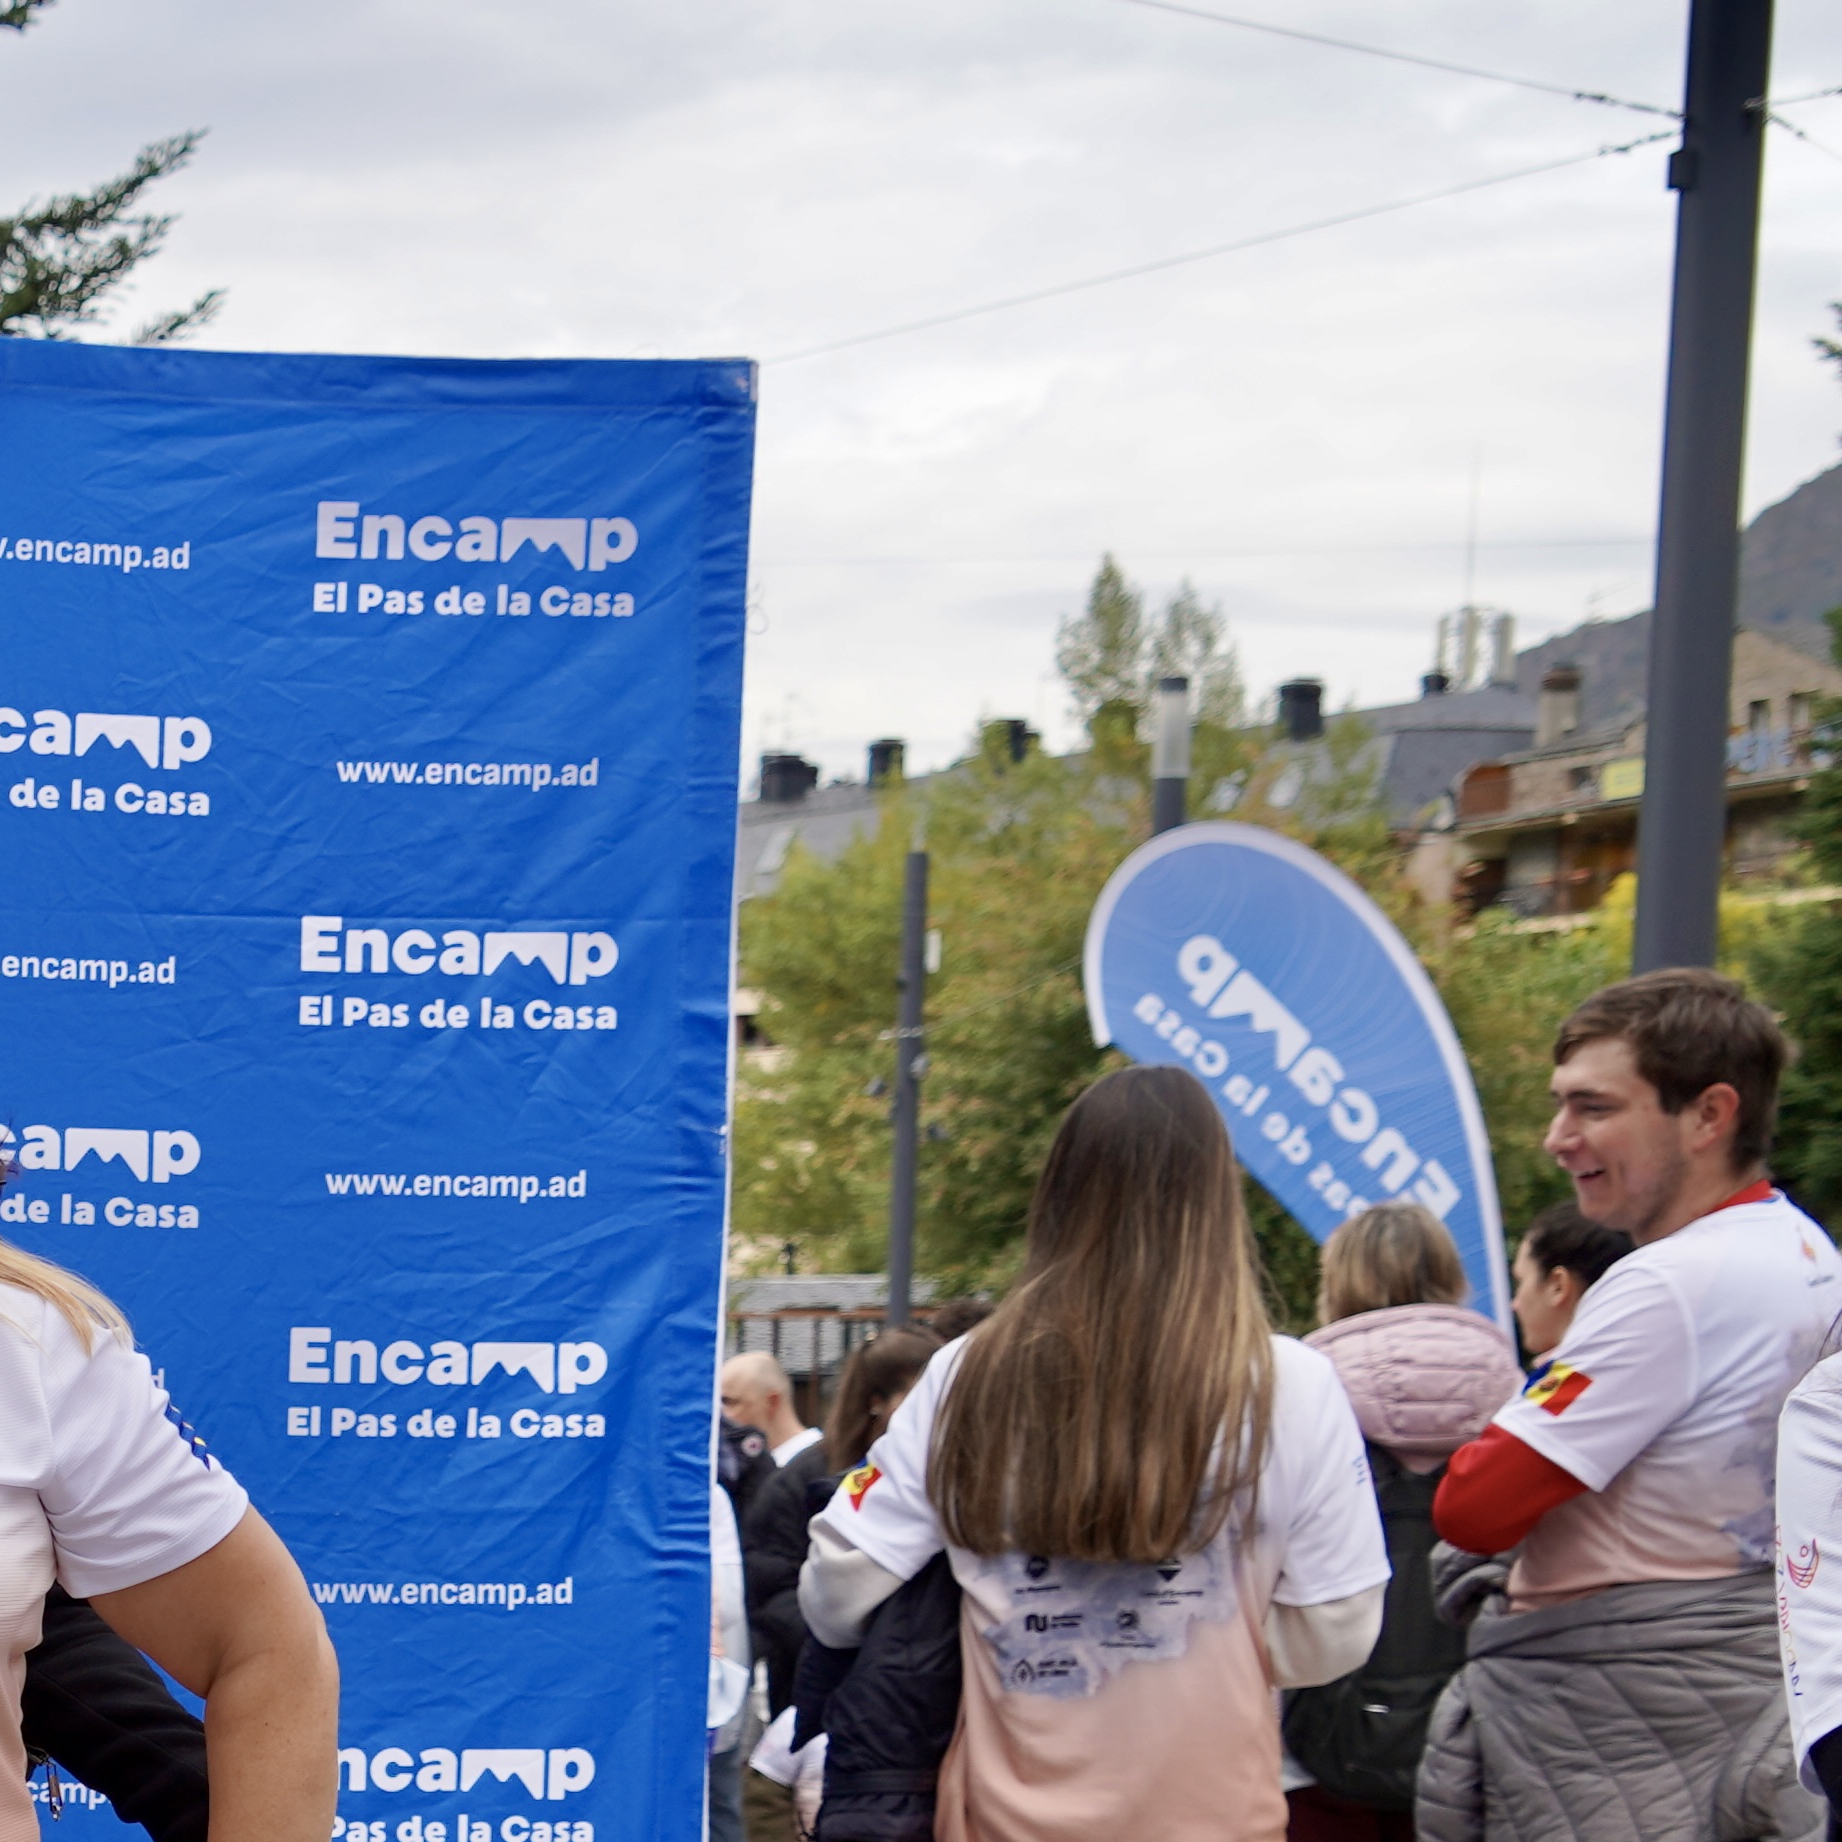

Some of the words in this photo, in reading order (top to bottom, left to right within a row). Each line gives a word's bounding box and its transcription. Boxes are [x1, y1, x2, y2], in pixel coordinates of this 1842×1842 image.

[315, 501, 638, 571] Encamp
[313, 581, 348, 613] El
[358, 583, 424, 615] Pas
[434, 585, 486, 616] de
[496, 583, 531, 616] la
[540, 586, 634, 617] Casa
[336, 757, 599, 792] www.encamp.ad
[9, 777, 60, 809] de
[71, 778, 106, 812] la
[114, 782, 210, 816] Casa
[300, 915, 619, 986] Encamp
[299, 995, 333, 1026] El
[343, 997, 410, 1028] Pas
[419, 998, 470, 1029] de
[480, 996, 515, 1029] la
[523, 999, 617, 1030] Casa
[325, 1169, 587, 1204] www.encamp.ad
[0, 1193, 50, 1224] de
[61, 1193, 96, 1225] la
[104, 1196, 199, 1229] Casa
[288, 1327, 608, 1395] Encamp
[287, 1405, 321, 1437] El
[331, 1407, 397, 1438] Pas
[406, 1408, 457, 1438] de
[466, 1407, 501, 1439] la
[509, 1408, 606, 1439] Casa
[312, 1576, 573, 1611] www.encamp.ad
[338, 1746, 596, 1801] ncamp
